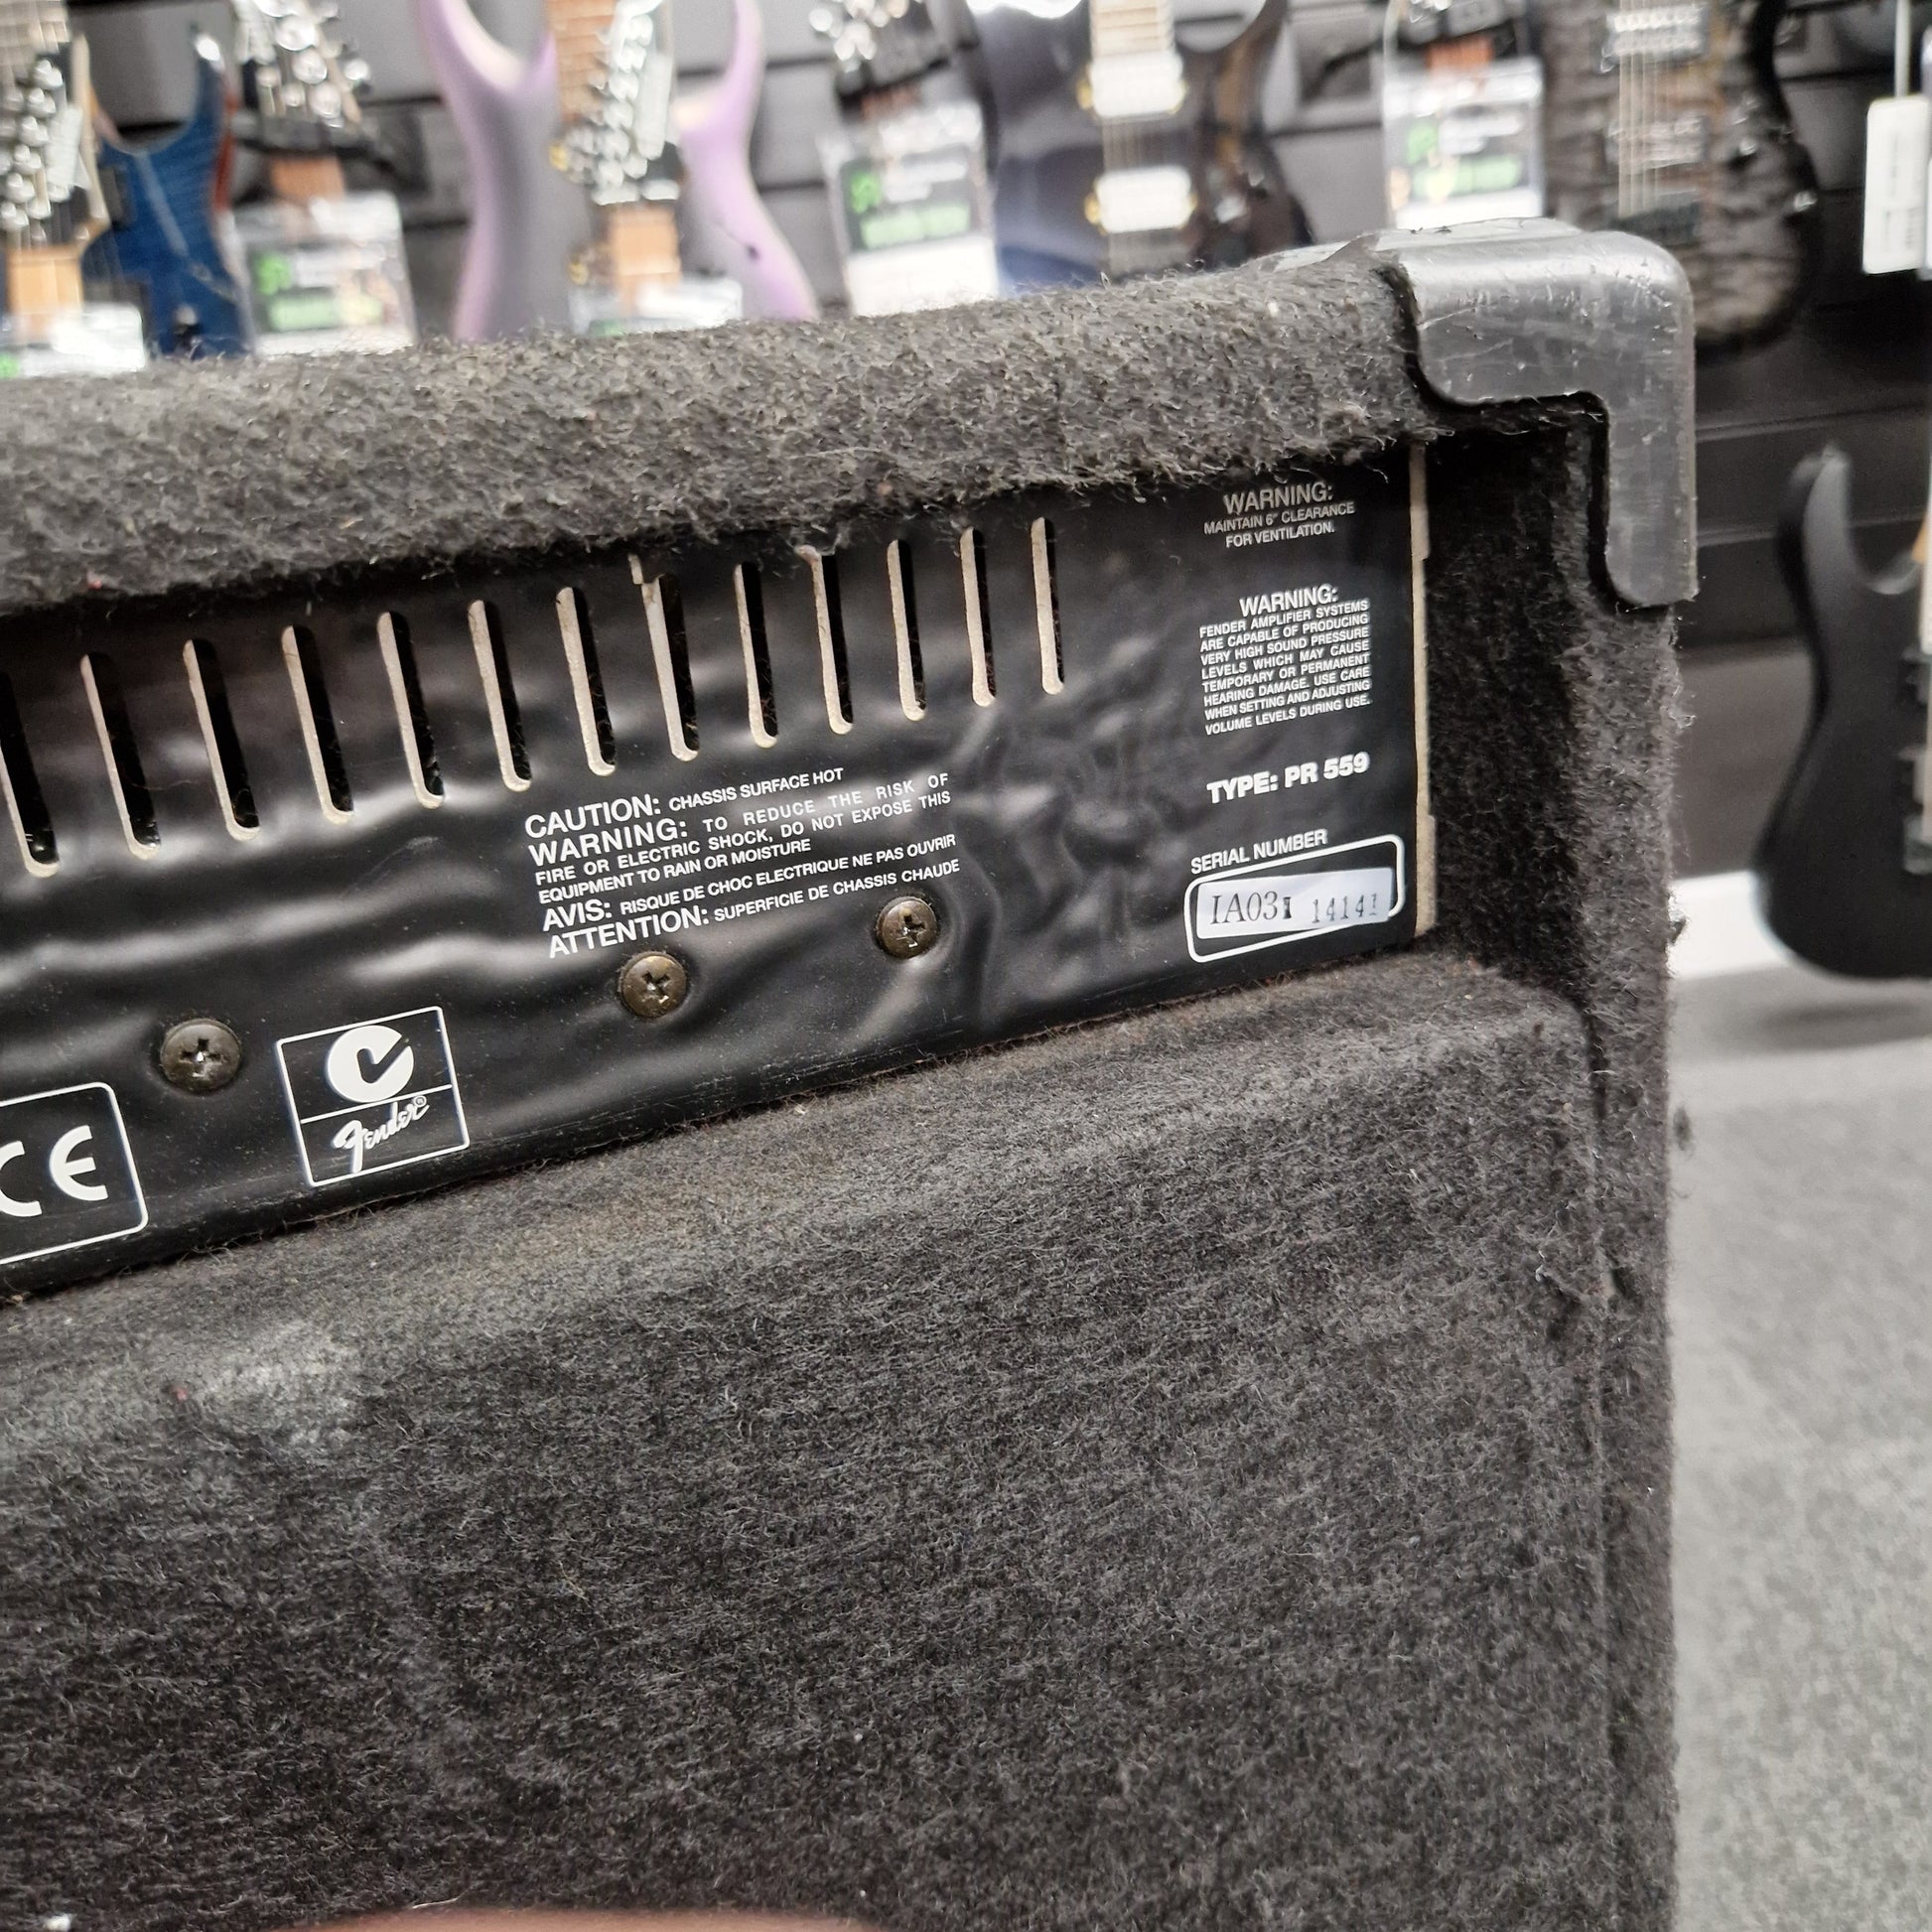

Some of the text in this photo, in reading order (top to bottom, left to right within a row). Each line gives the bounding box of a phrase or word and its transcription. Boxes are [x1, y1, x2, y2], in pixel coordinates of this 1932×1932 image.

[1204, 515, 1263, 534] MAINTAIN
[1282, 501, 1355, 523] CLEARANCE
[1223, 482, 1333, 514] WARNING:
[1226, 522, 1334, 548] FOR VENTILATION.
[1199, 599, 1368, 638] FENDER AMPLIFIER SYSTEMS
[1239, 584, 1338, 617] WARNING:
[1200, 614, 1369, 652] ARE CAPABLE OF PRODUCING
[1201, 627, 1369, 666] VERY HIGH SOUND PRESSURE
[1201, 641, 1369, 679] LEVELS WHICH MAY CAUSE
[1202, 654, 1369, 693] TEMPORARY OR PERMANENT
[1204, 667, 1371, 707] HEARING DAMAGE. USE CARE
[1205, 680, 1371, 721] WHEN SETTING AND ADJUSTING
[1205, 696, 1371, 736] VOLUME LEVELS DURING USE.
[1206, 752, 1370, 803] TYPE: PR 559
[525, 767, 844, 839] CAUTION: CHASSIS SURFACE HOT
[528, 773, 949, 867] WARNING: TO REDUCE THE RISK OF
[535, 791, 951, 886] FIRE OR ELECTRIC SHOCK, DO NOT EXPOSE THIS
[1191, 829, 1328, 875] SERIAL NUMBER
[539, 839, 811, 904] EQUIPMENT TO RAIN OR MOISTURE
[542, 834, 957, 931] AVIS: RISQUE DE CHOC ELECTRIQUE NE PAS OUVRIR
[549, 859, 960, 958] ATTENTION: SUPERFICIE DE CHASSIS CHAUDE
